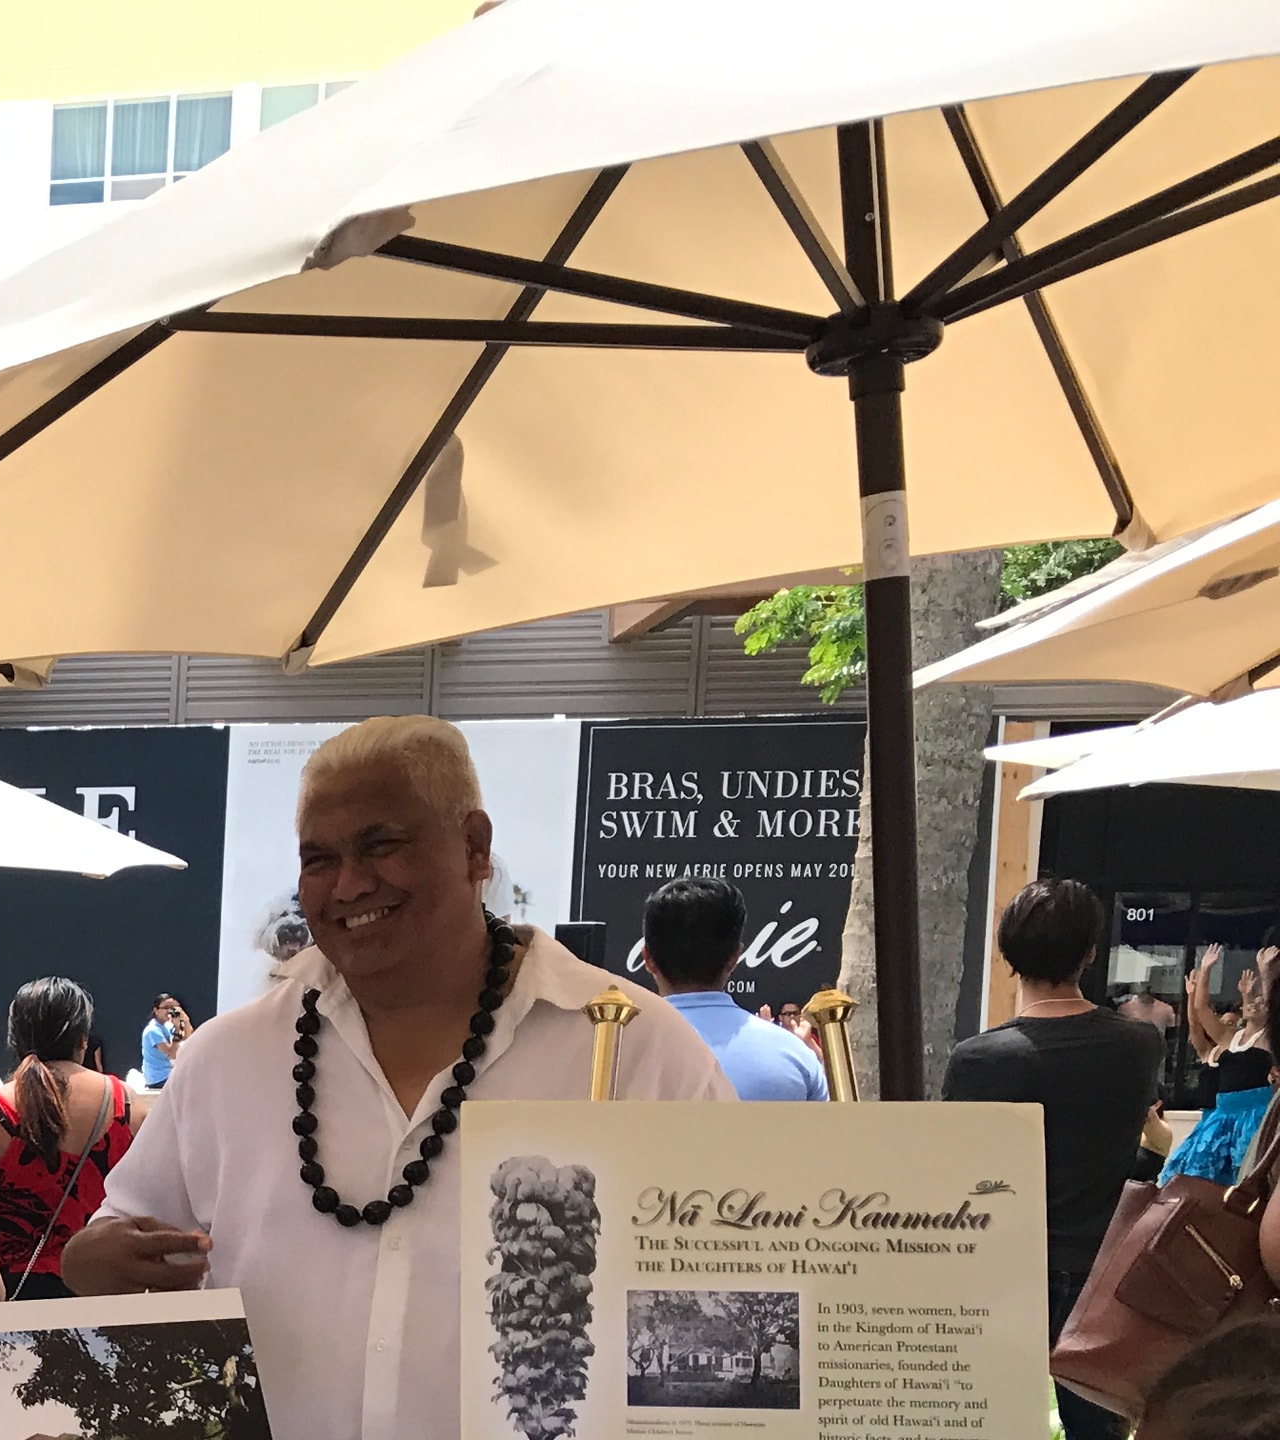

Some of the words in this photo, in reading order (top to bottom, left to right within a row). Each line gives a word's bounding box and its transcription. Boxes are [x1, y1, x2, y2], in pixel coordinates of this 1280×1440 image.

[606, 771, 704, 805] BRAS,
[599, 810, 698, 839] SWIM
[712, 809, 741, 838] &
[598, 863, 639, 878] YOUR
[645, 863, 678, 878] NEW
[733, 863, 784, 878] OPENS
[790, 863, 823, 878] MAY
[828, 863, 855, 878] 201
[1126, 907, 1155, 922] 801
[817, 1302, 832, 1314] In
[835, 1304, 869, 1317] 1903,
[871, 1307, 905, 1315] seven
[907, 1308, 957, 1318] women,
[959, 1305, 990, 1316] born
[816, 1321, 830, 1332] in
[832, 1321, 853, 1333] the
[855, 1322, 914, 1336] Kingdom
[916, 1323, 932, 1334] of
[817, 1342, 831, 1351] to
[832, 1340, 893, 1352] American
[895, 1341, 958, 1353] Protestant
[817, 1359, 895, 1373] missionaries,
[897, 1360, 949, 1371] founded
[951, 1361, 971, 1371] the
[818, 1376, 882, 1391] Daughters
[883, 1378, 899, 1389] of
[817, 1398, 884, 1410] perpetuate
[886, 1396, 906, 1408] the
[908, 1400, 962, 1412] memory
[963, 1398, 989, 1409] and
[817, 1414, 849, 1428] spirit
[851, 1415, 867, 1425] of
[868, 1414, 890, 1426] old
[943, 1417, 968, 1427] and
[970, 1417, 986, 1428] of
